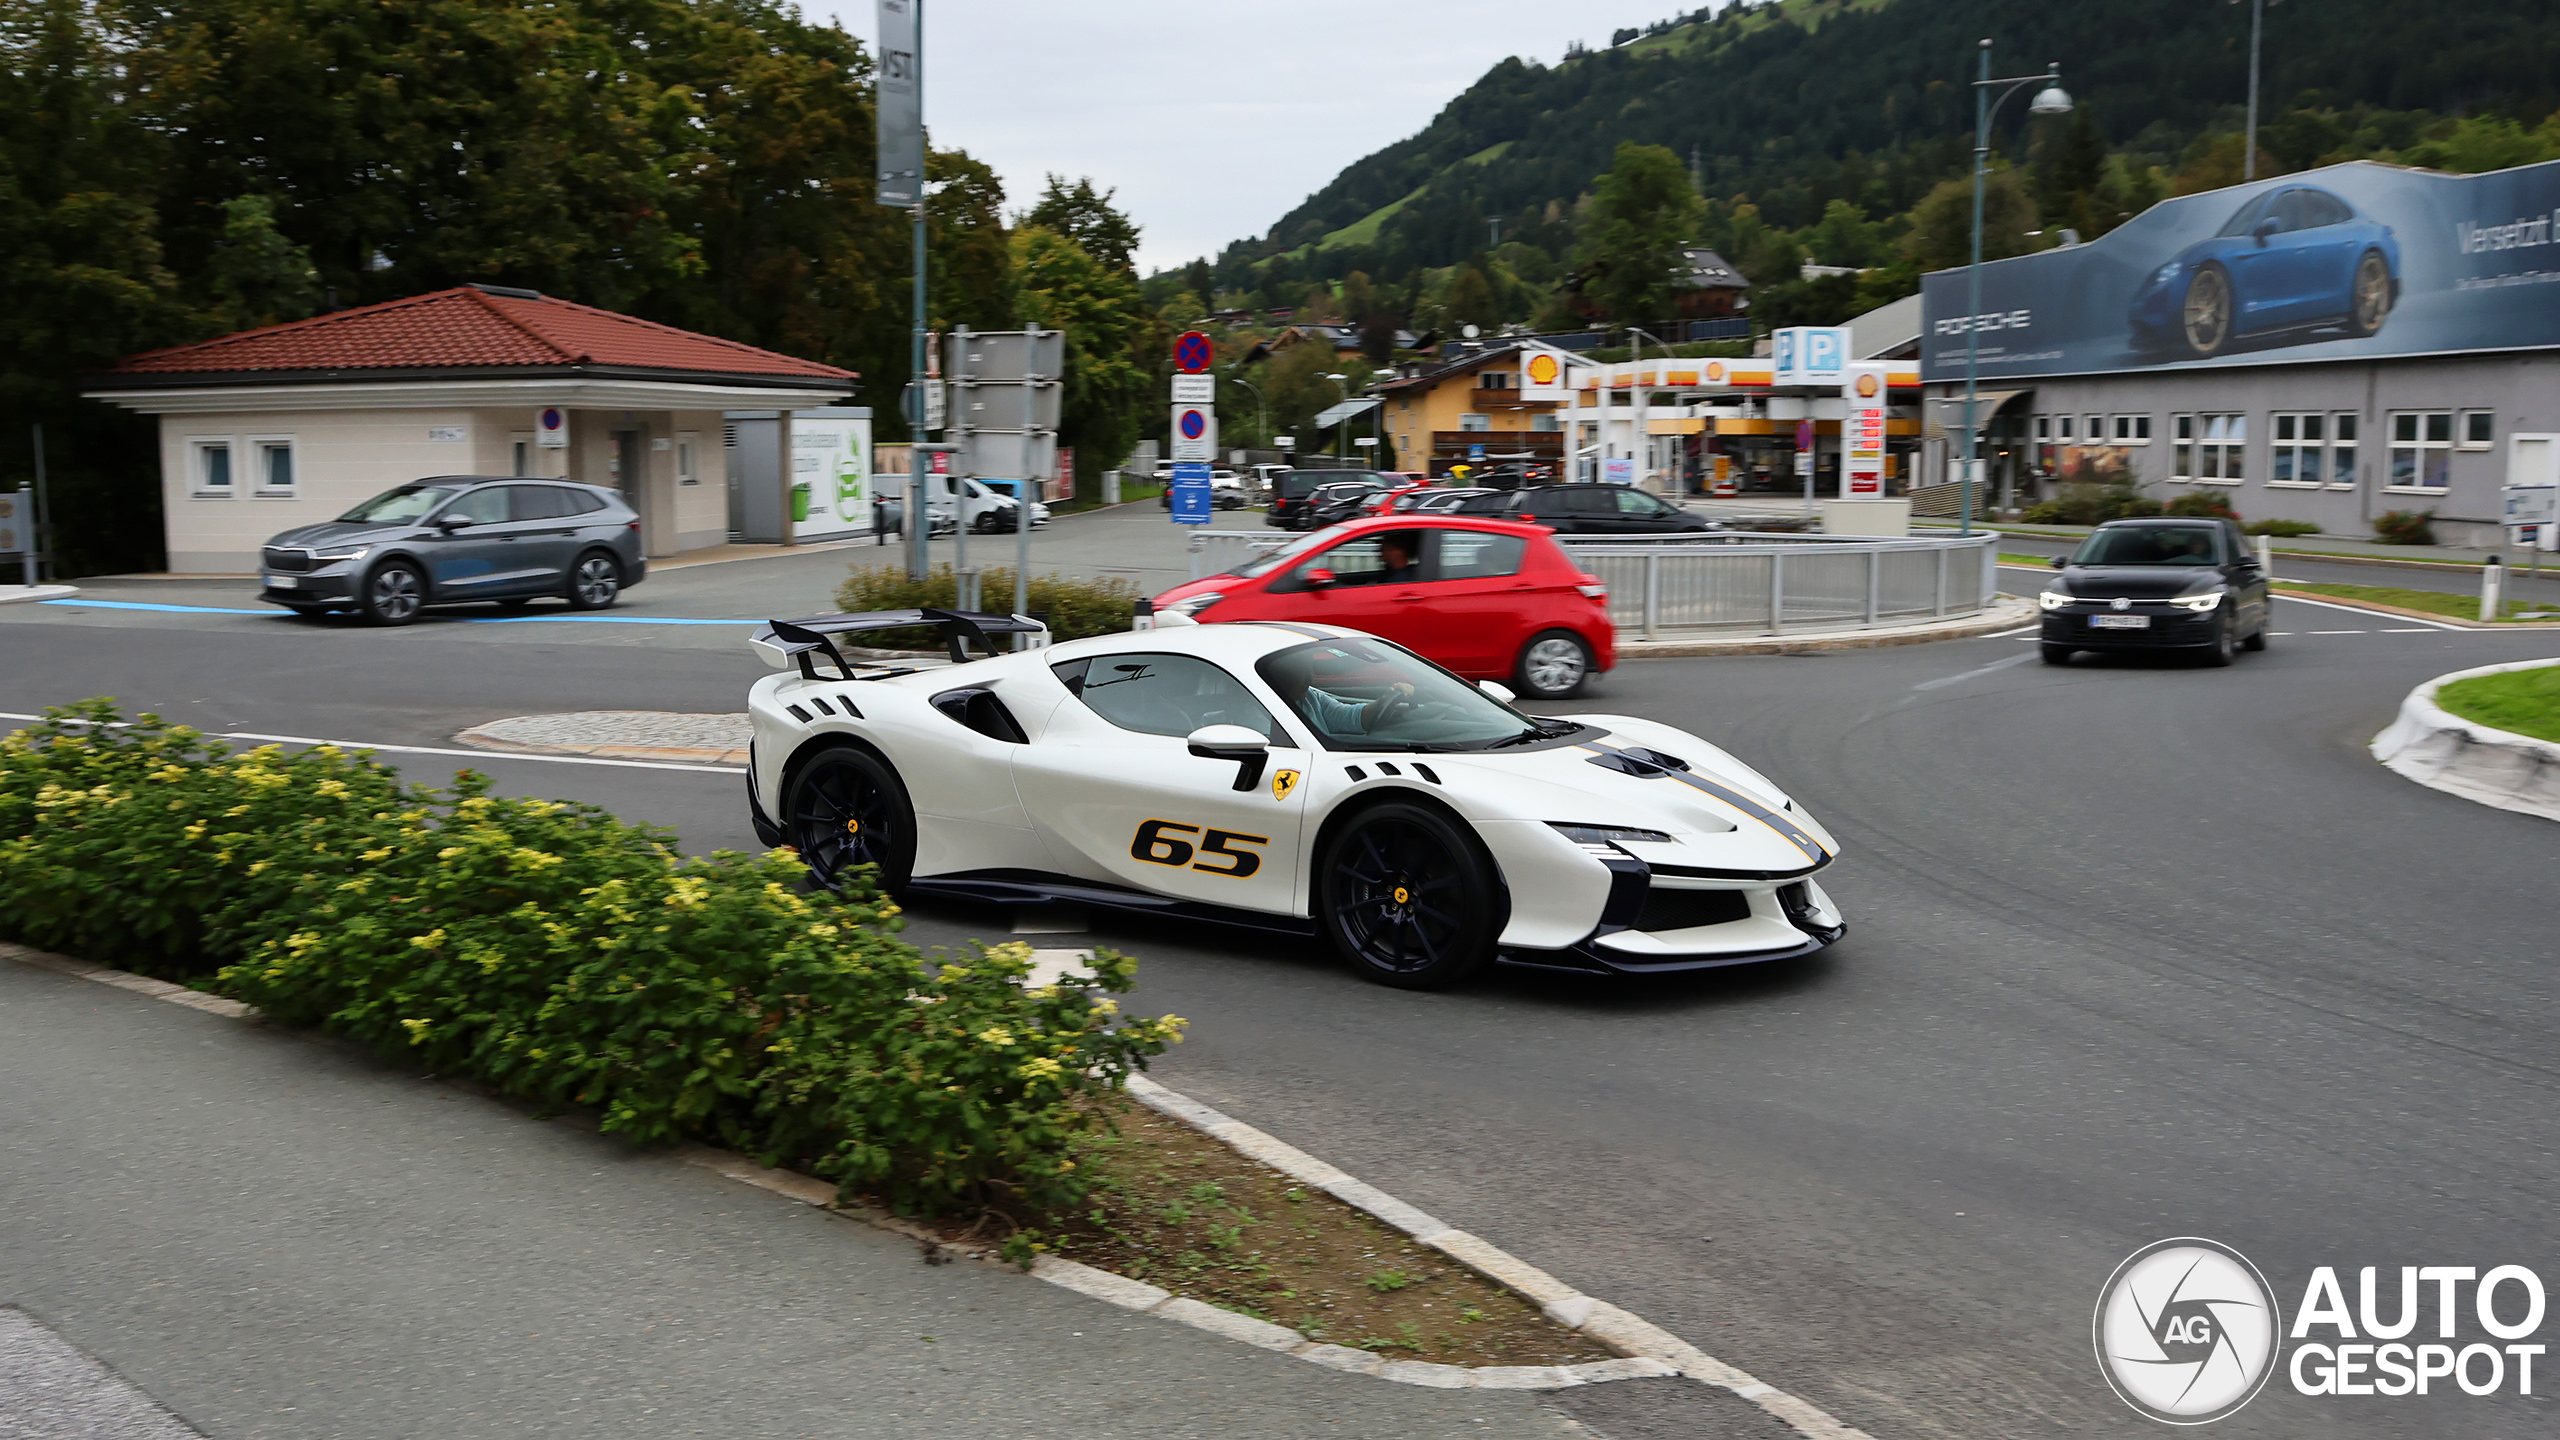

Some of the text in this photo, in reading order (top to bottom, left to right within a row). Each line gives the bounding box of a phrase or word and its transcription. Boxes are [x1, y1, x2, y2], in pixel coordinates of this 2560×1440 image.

[2457, 214, 2551, 255] Versetzt
[1810, 334, 1836, 367] P
[1130, 818, 1270, 880] 65
